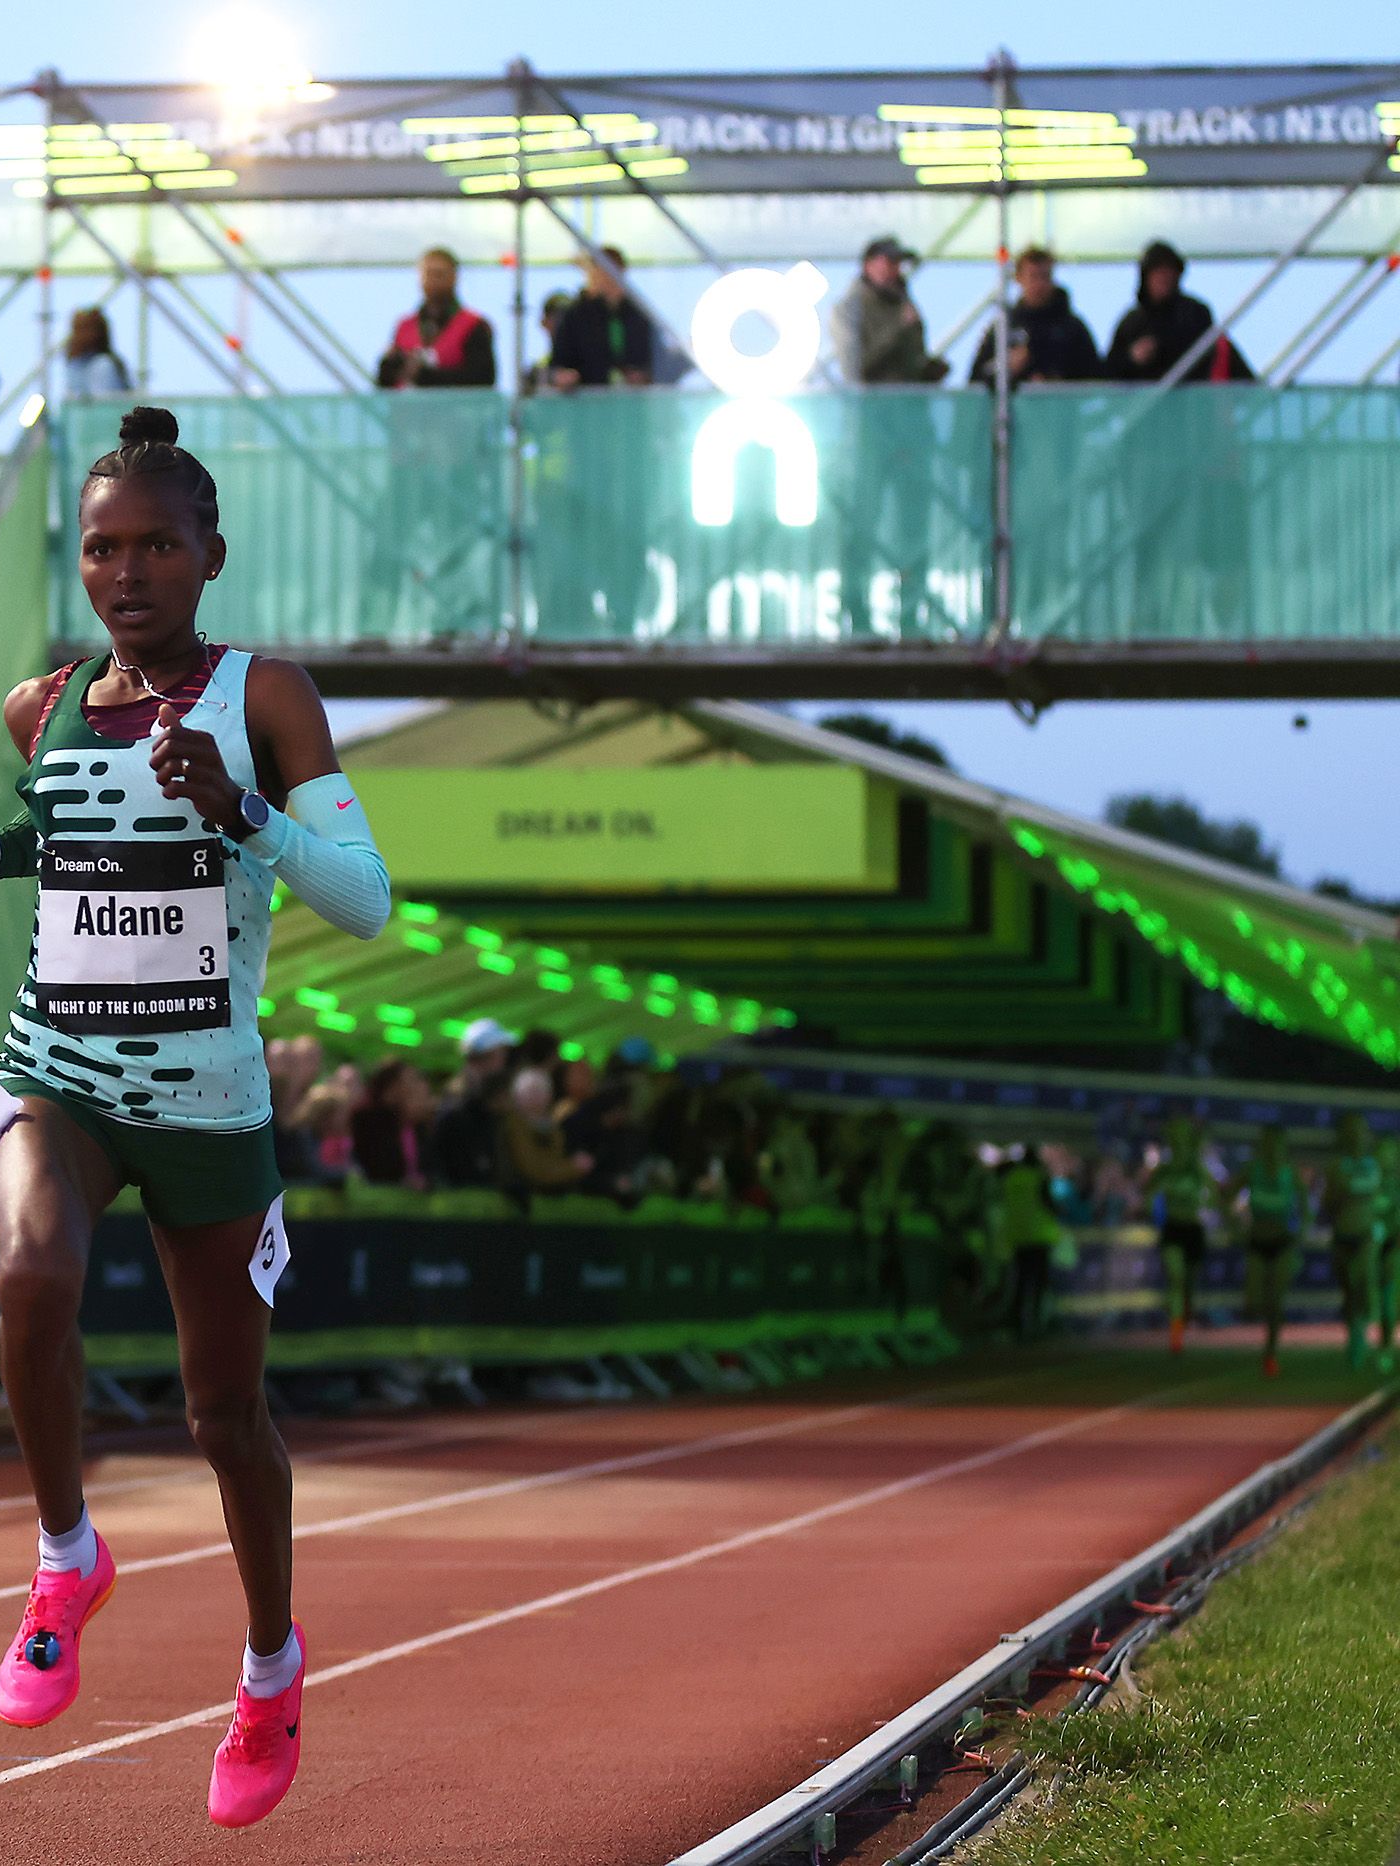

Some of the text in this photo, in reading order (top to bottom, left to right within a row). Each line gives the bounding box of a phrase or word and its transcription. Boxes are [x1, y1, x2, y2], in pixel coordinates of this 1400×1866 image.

[498, 810, 602, 841] DREAM
[55, 857, 124, 873] Dream On.
[73, 895, 184, 936] Adane
[198, 945, 216, 976] 3
[48, 997, 217, 1016] NIGHT OF THE 10,000M PB'S
[260, 1226, 276, 1272] 3
